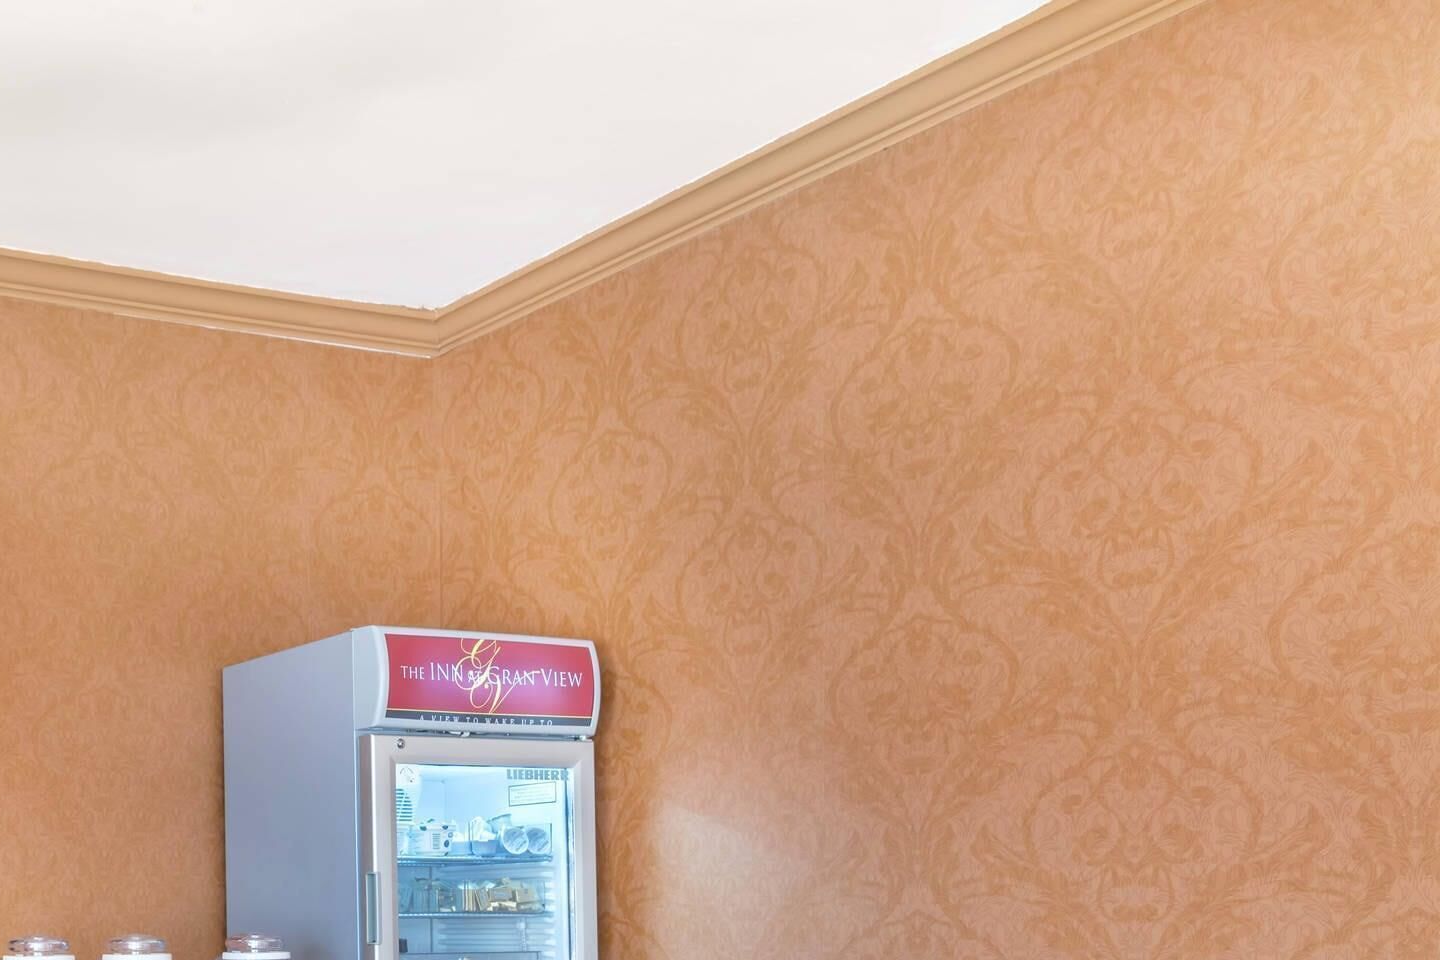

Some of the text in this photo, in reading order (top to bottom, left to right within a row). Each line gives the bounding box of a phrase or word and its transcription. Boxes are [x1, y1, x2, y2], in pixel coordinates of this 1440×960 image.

[400, 665, 425, 681] THE
[429, 662, 464, 683] INN
[487, 665, 535, 686] GRAN
[540, 668, 583, 688] VIEW
[466, 716, 479, 724] TO
[485, 717, 515, 725] WAKE
[506, 768, 569, 781] LIEBHERR
